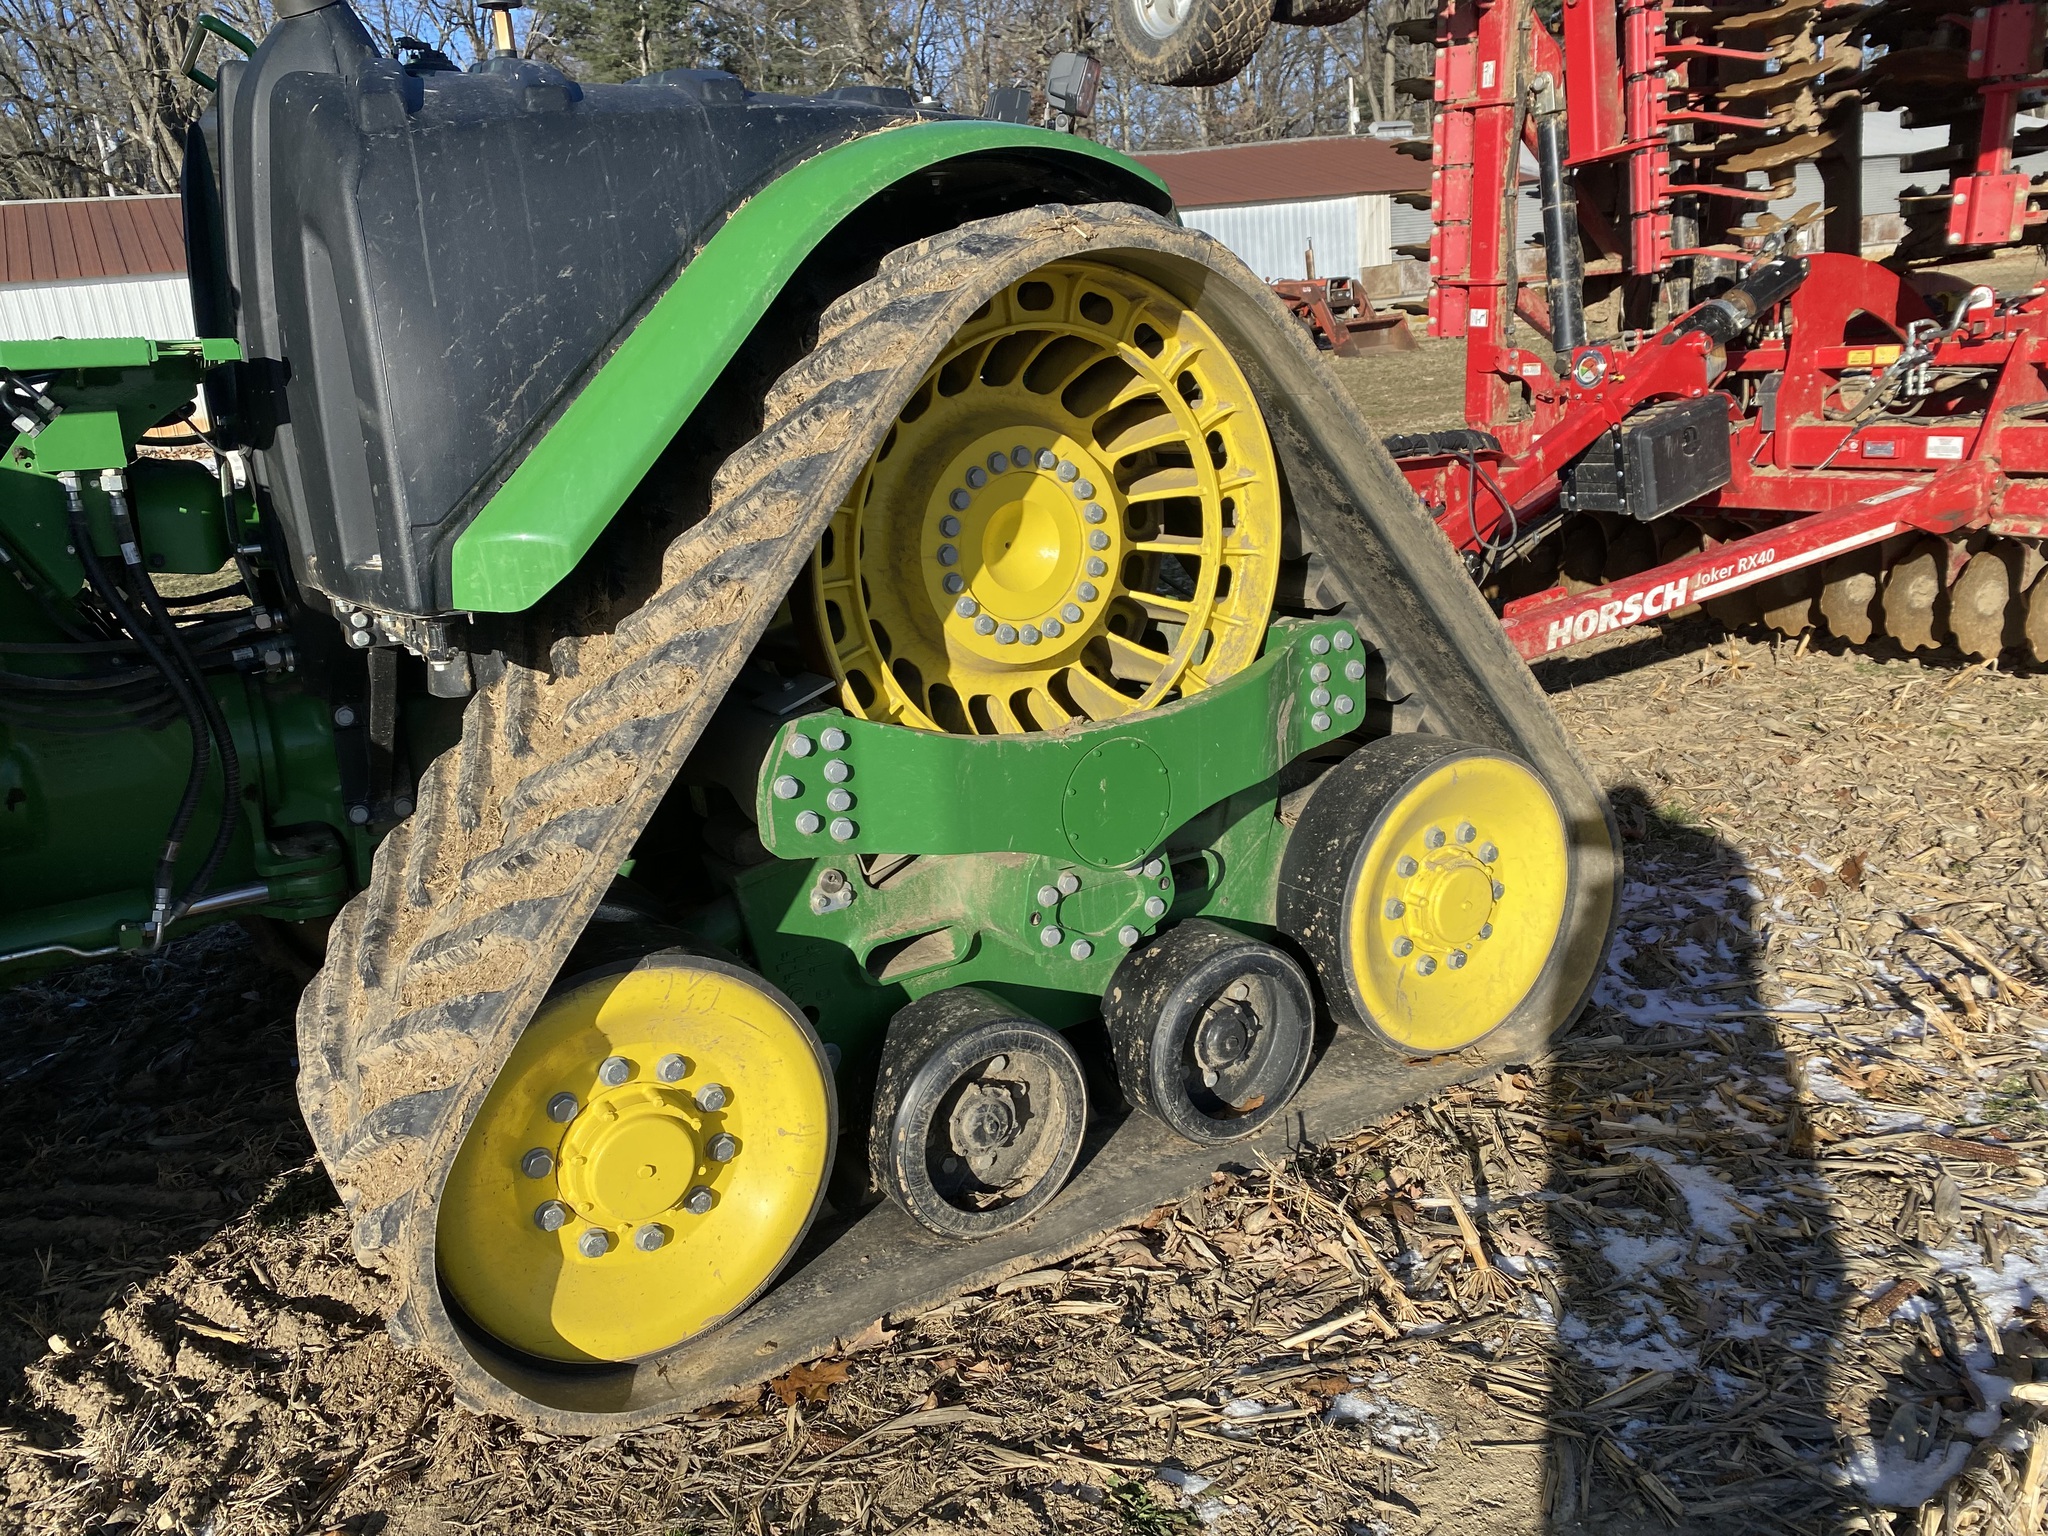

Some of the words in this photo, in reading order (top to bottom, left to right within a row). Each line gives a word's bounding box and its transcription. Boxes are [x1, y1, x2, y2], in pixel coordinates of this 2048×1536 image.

[1546, 577, 1689, 651] HORSCH
[1694, 564, 1735, 588] Joker
[1737, 548, 1775, 573] RX40
